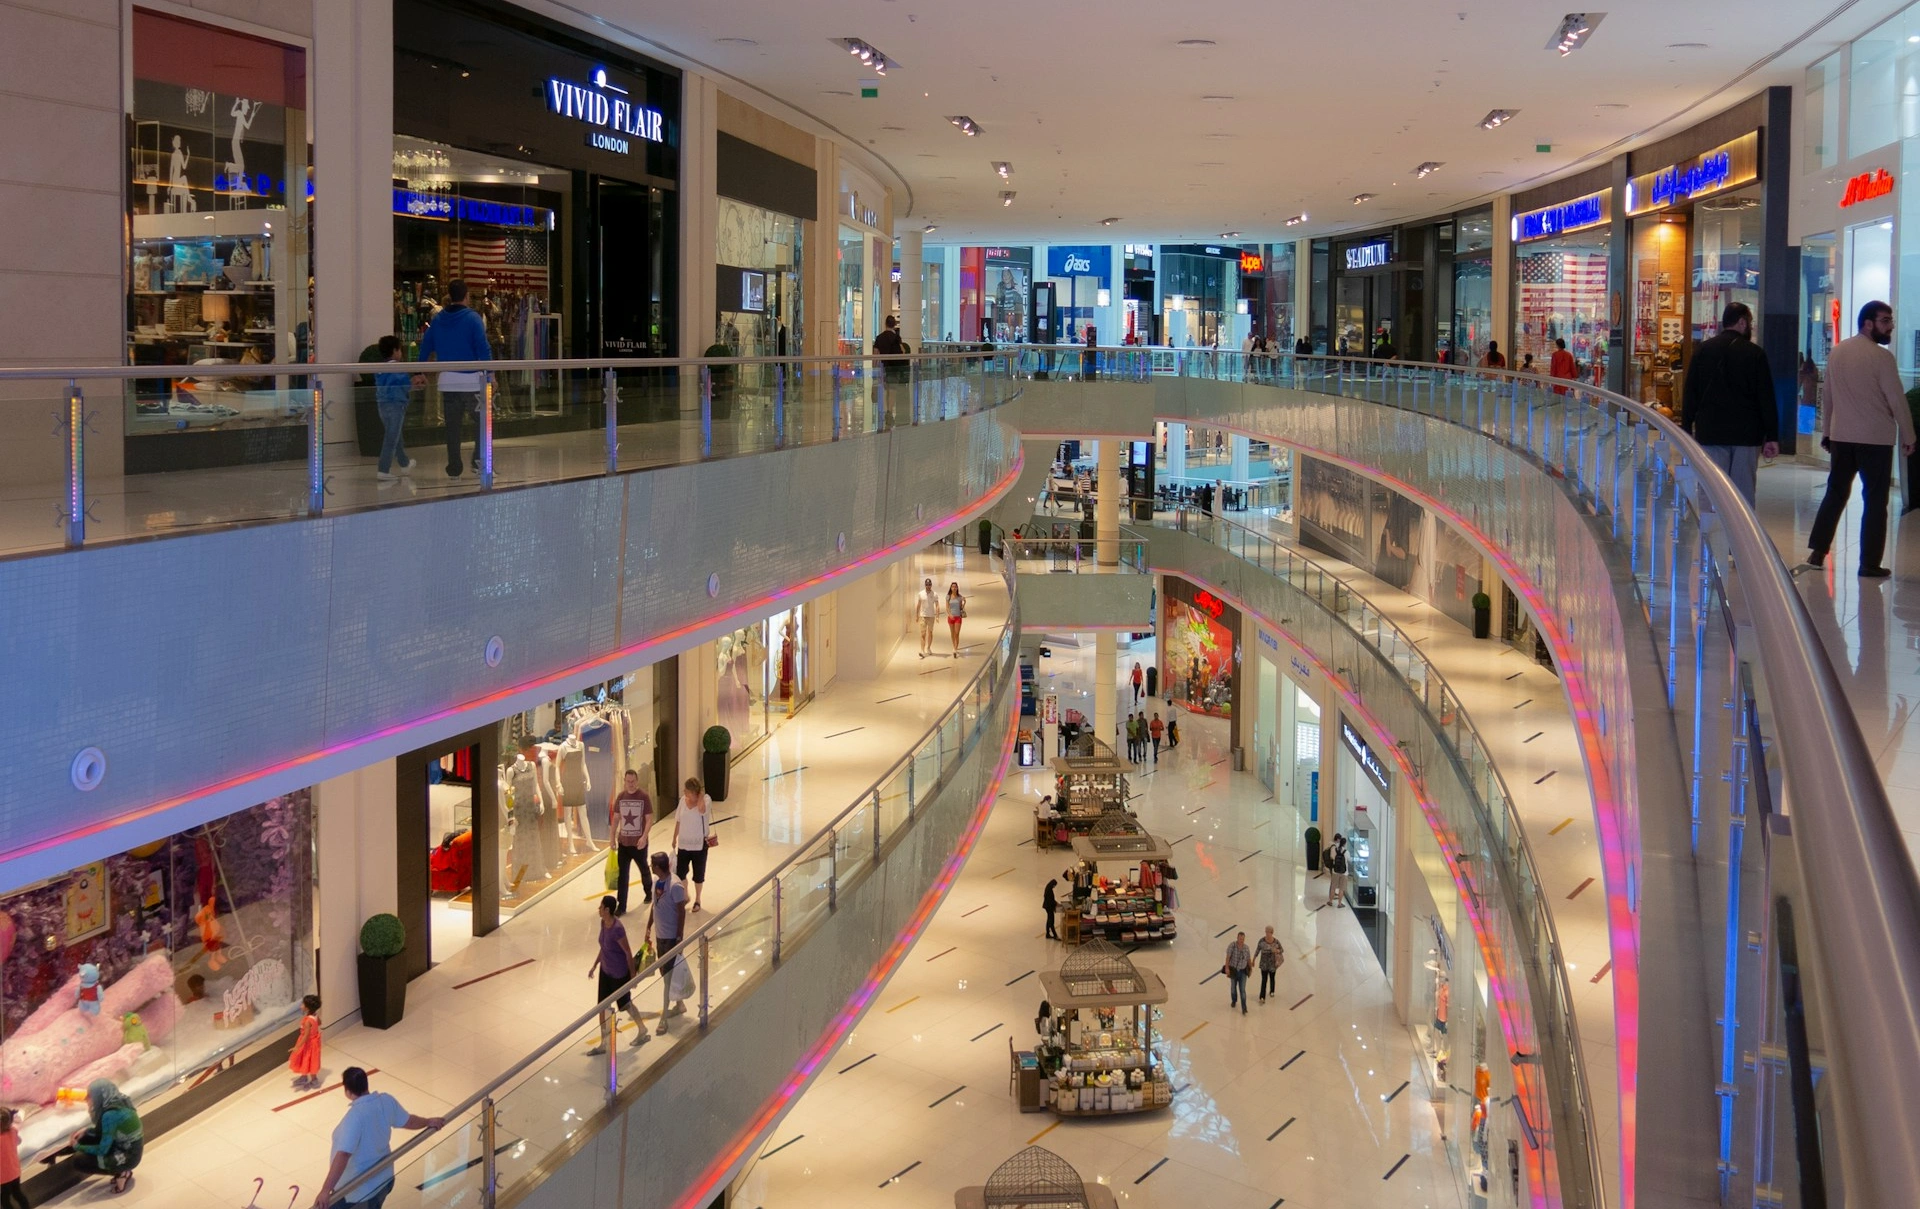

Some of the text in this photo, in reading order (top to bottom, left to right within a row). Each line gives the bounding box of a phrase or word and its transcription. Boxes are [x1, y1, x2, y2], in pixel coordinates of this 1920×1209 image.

[551, 79, 663, 142] VIVID FLAIR
[592, 132, 629, 154] LONDON
[1345, 243, 1386, 270] STADIUM
[605, 340, 626, 349] VIVID
[626, 341, 648, 349] FLAIR
